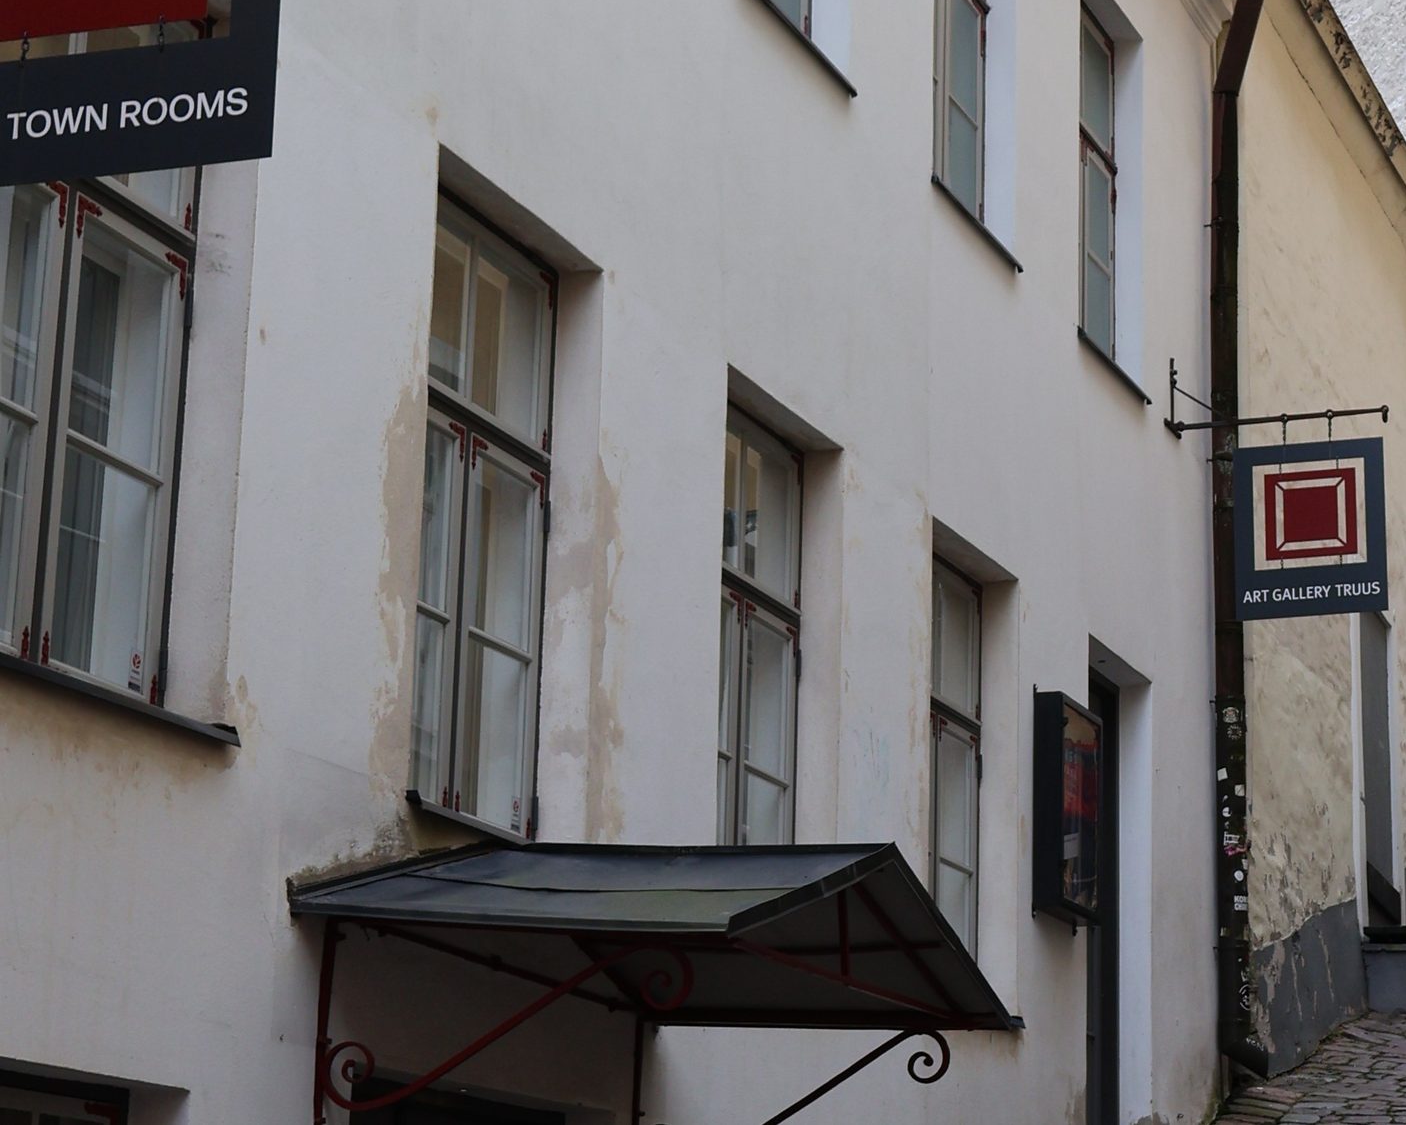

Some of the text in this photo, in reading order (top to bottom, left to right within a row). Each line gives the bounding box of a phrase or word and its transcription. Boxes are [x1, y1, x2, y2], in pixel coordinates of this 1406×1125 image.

[6, 87, 249, 140] TOWN ROOMS
[1243, 581, 1381, 603] ART GALLERY TRUUS
